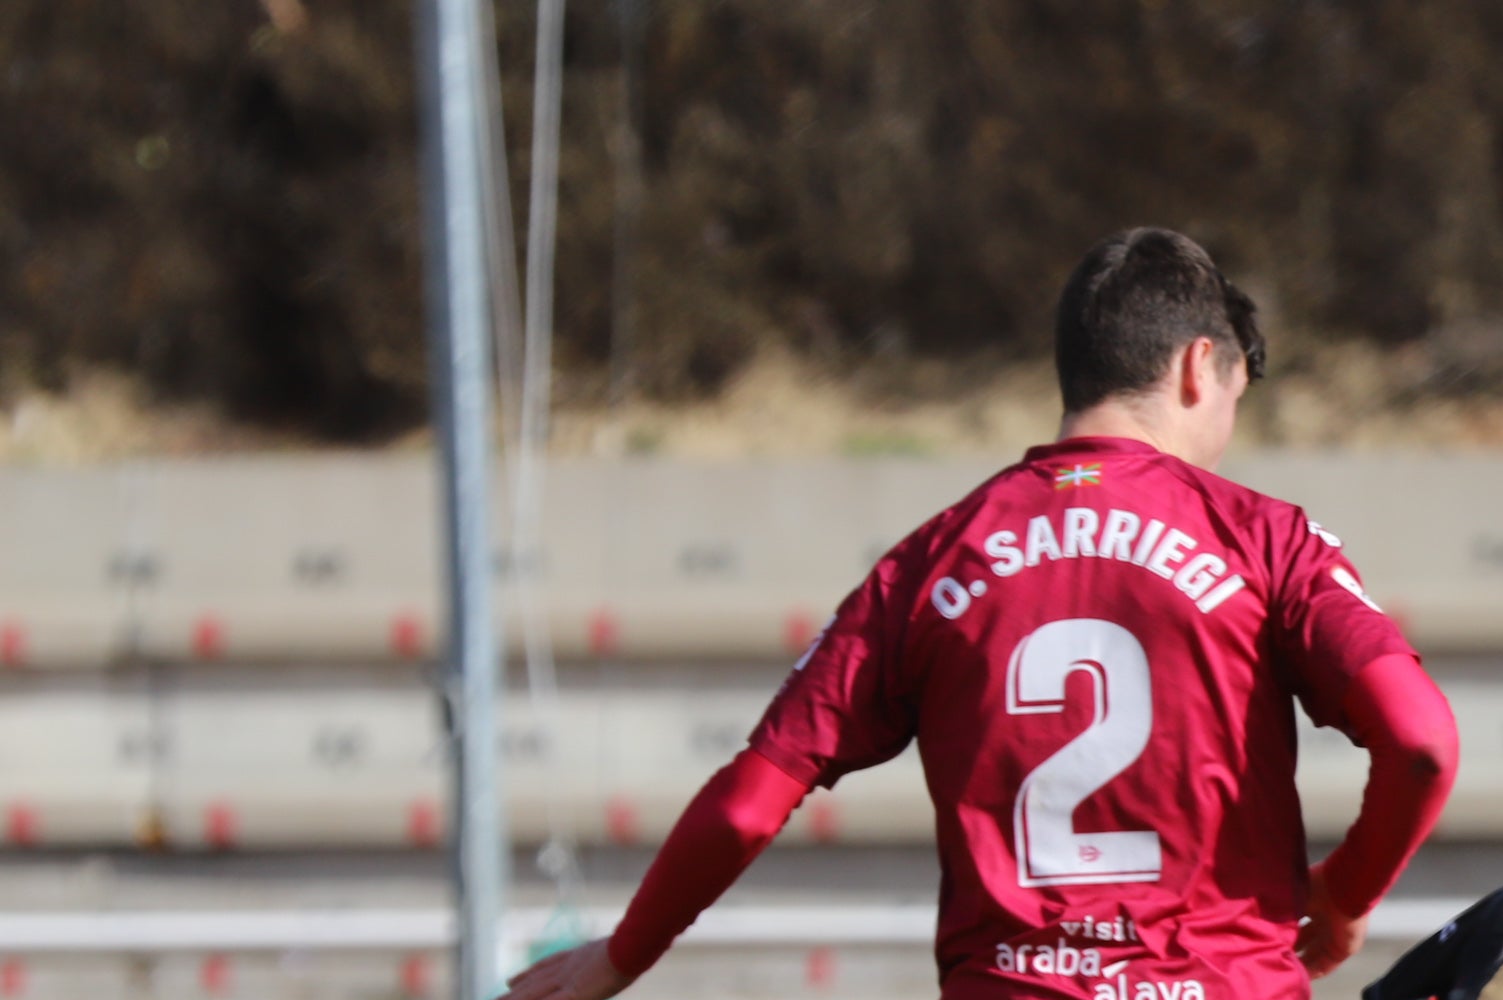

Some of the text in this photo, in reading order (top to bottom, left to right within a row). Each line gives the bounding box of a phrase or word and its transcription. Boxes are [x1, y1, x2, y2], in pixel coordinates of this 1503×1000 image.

[930, 506, 1246, 620] O. SARRIEGI
[1006, 617, 1162, 888] 2
[995, 937, 1101, 978] araba
[1059, 915, 1139, 942] visit
